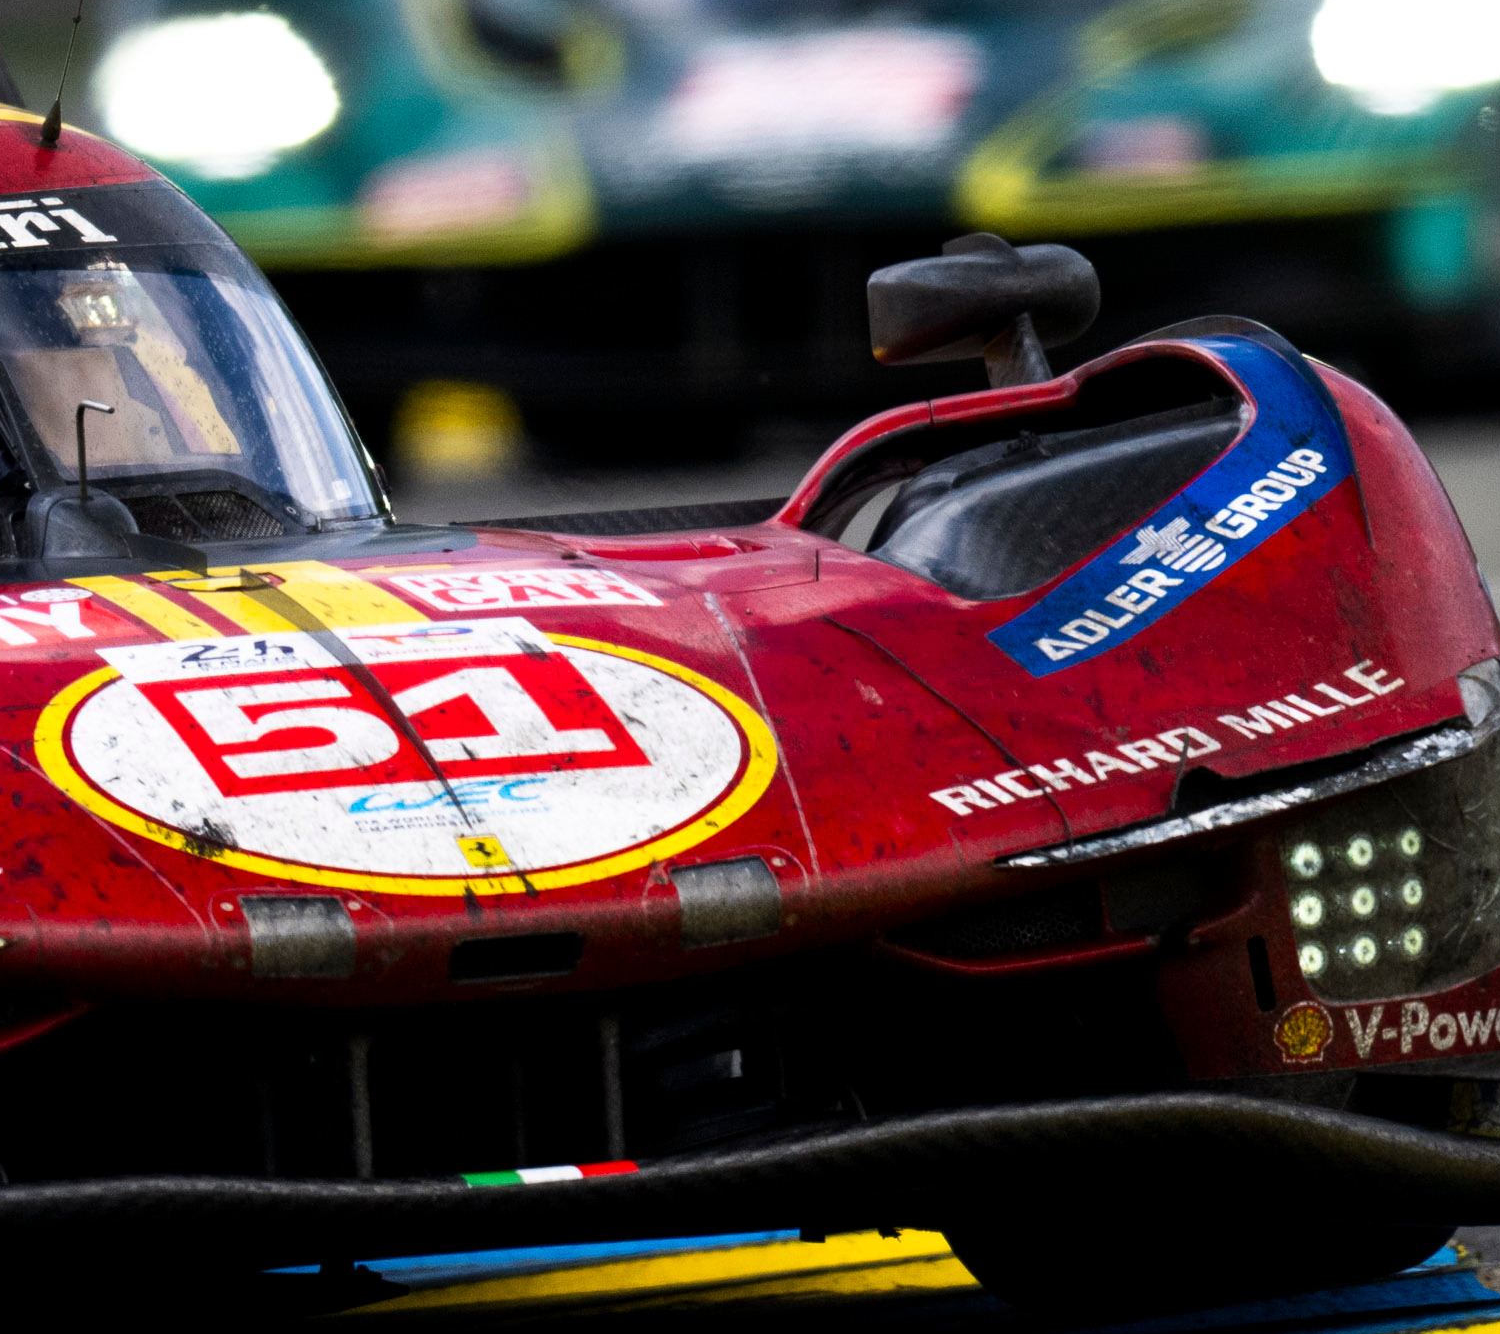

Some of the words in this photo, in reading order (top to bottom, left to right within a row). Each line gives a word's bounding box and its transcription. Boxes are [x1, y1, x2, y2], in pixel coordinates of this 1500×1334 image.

[431, 583, 643, 606] CAR
[1032, 567, 1185, 662] ADLER
[1205, 448, 1328, 540] GROUP
[174, 665, 618, 780] 51
[928, 725, 1222, 817] RICHARD
[1216, 658, 1405, 740] MILLE
